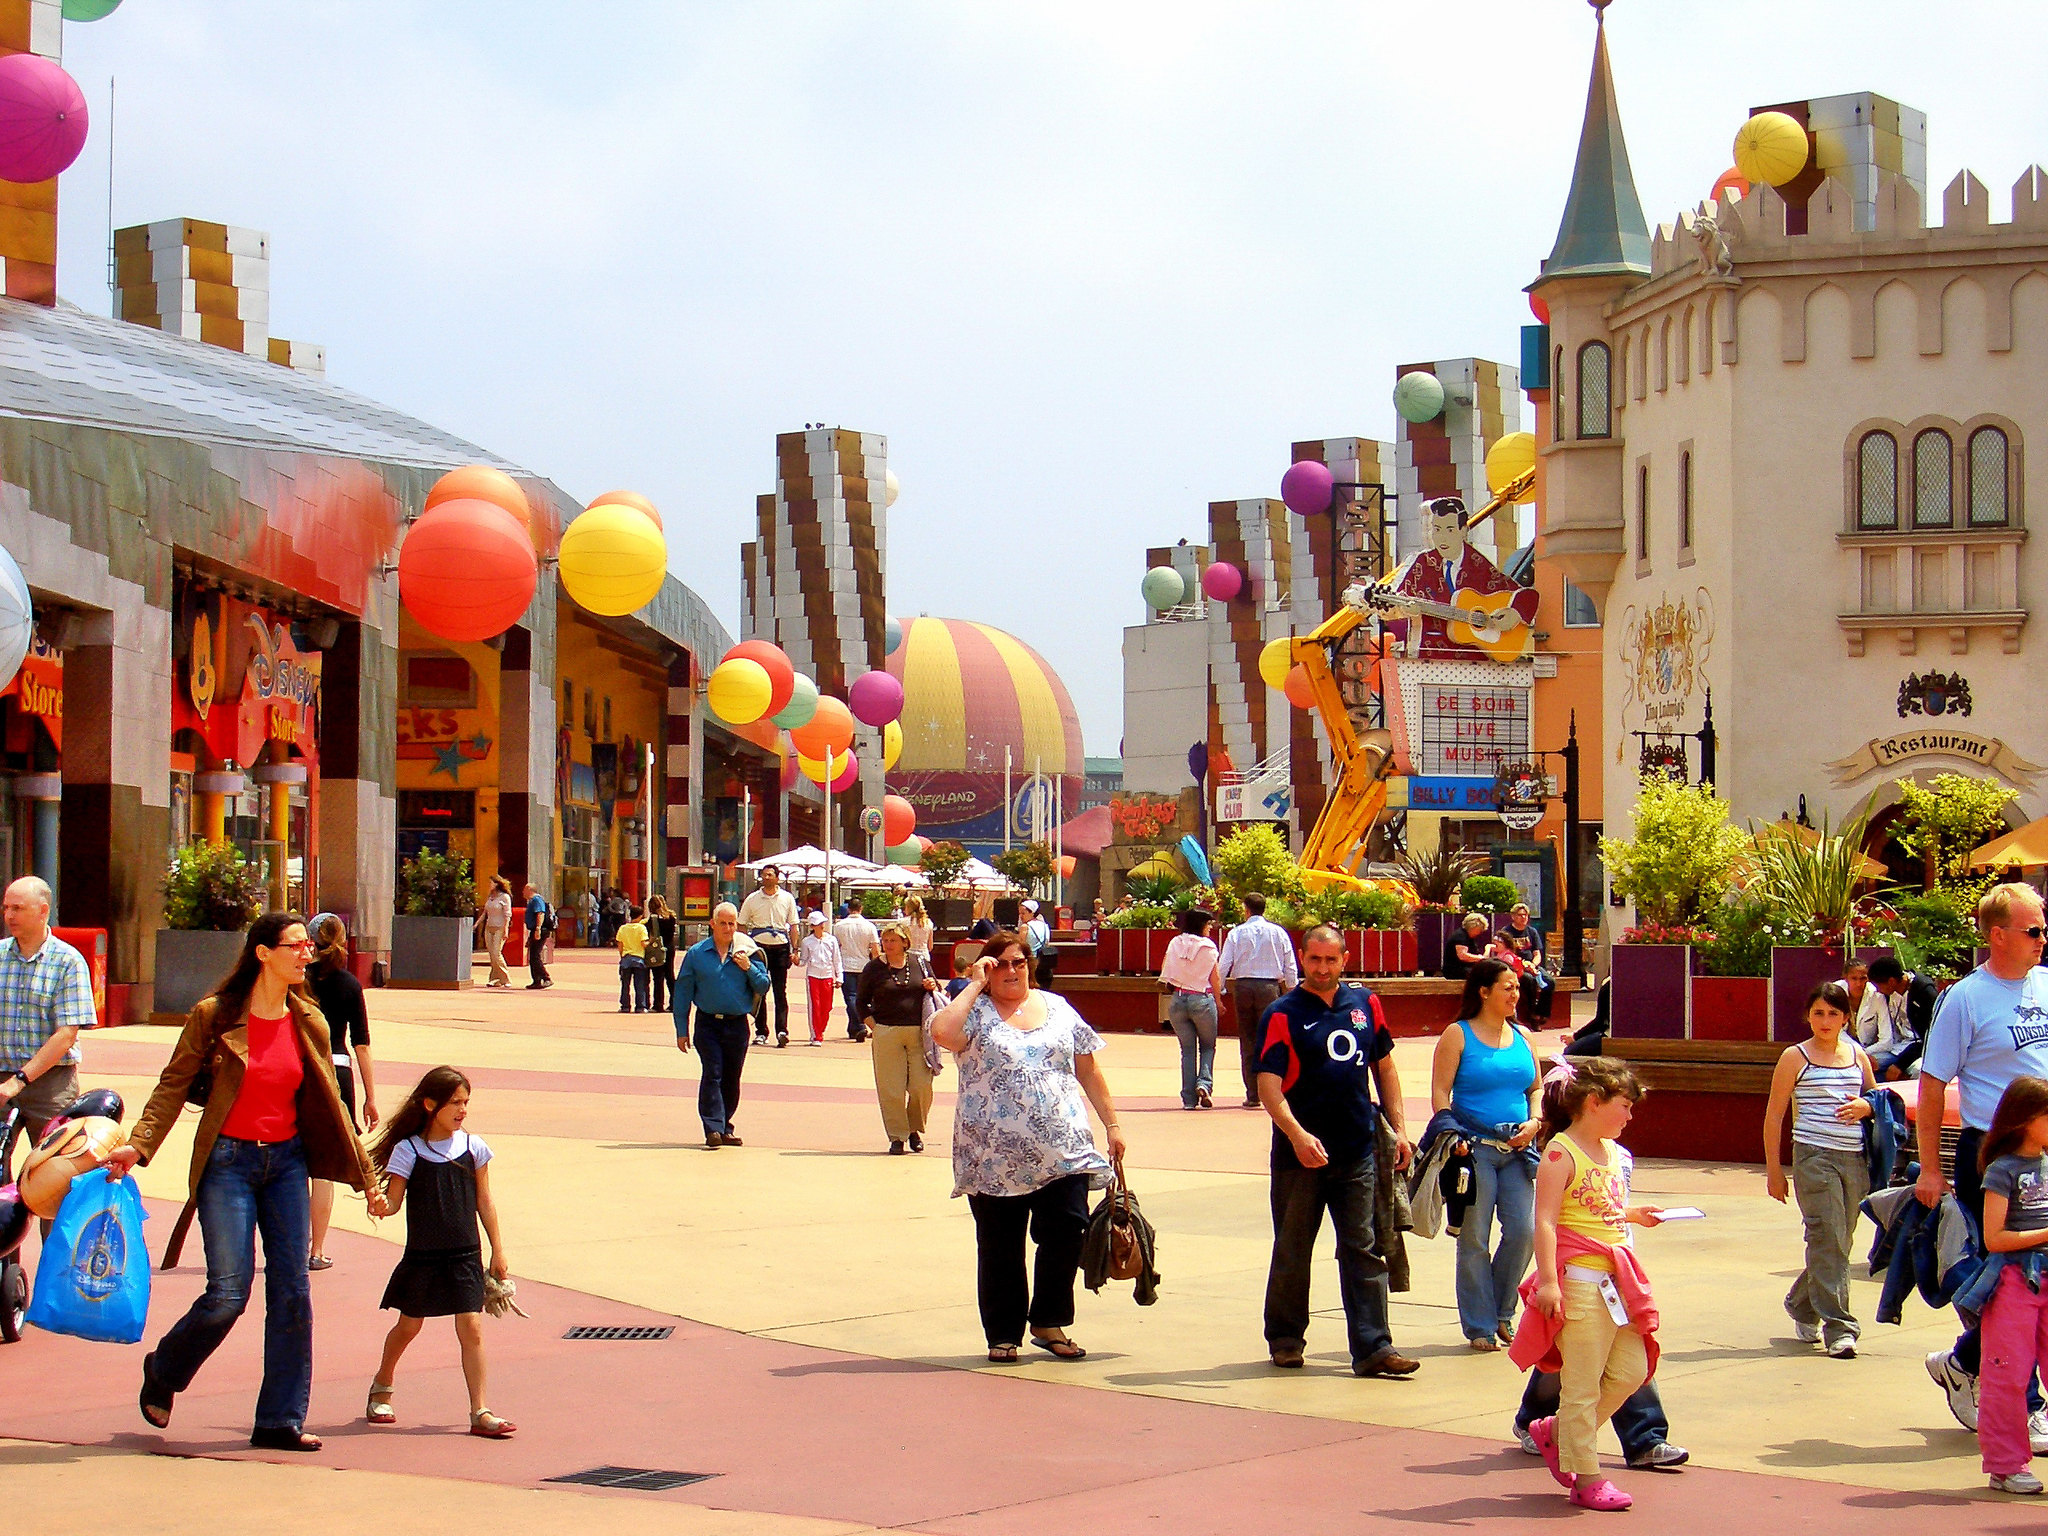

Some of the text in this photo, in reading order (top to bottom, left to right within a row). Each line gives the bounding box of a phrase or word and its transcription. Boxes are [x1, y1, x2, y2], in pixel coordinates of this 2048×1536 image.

[22, 670, 64, 718] Store
[1436, 695, 1516, 712] CE SOIR
[1456, 721, 1496, 737] LIVE
[1445, 746, 1505, 762] MUSIC
[1879, 734, 1988, 760] Restaurant
[1412, 785, 1457, 804] BILLY
